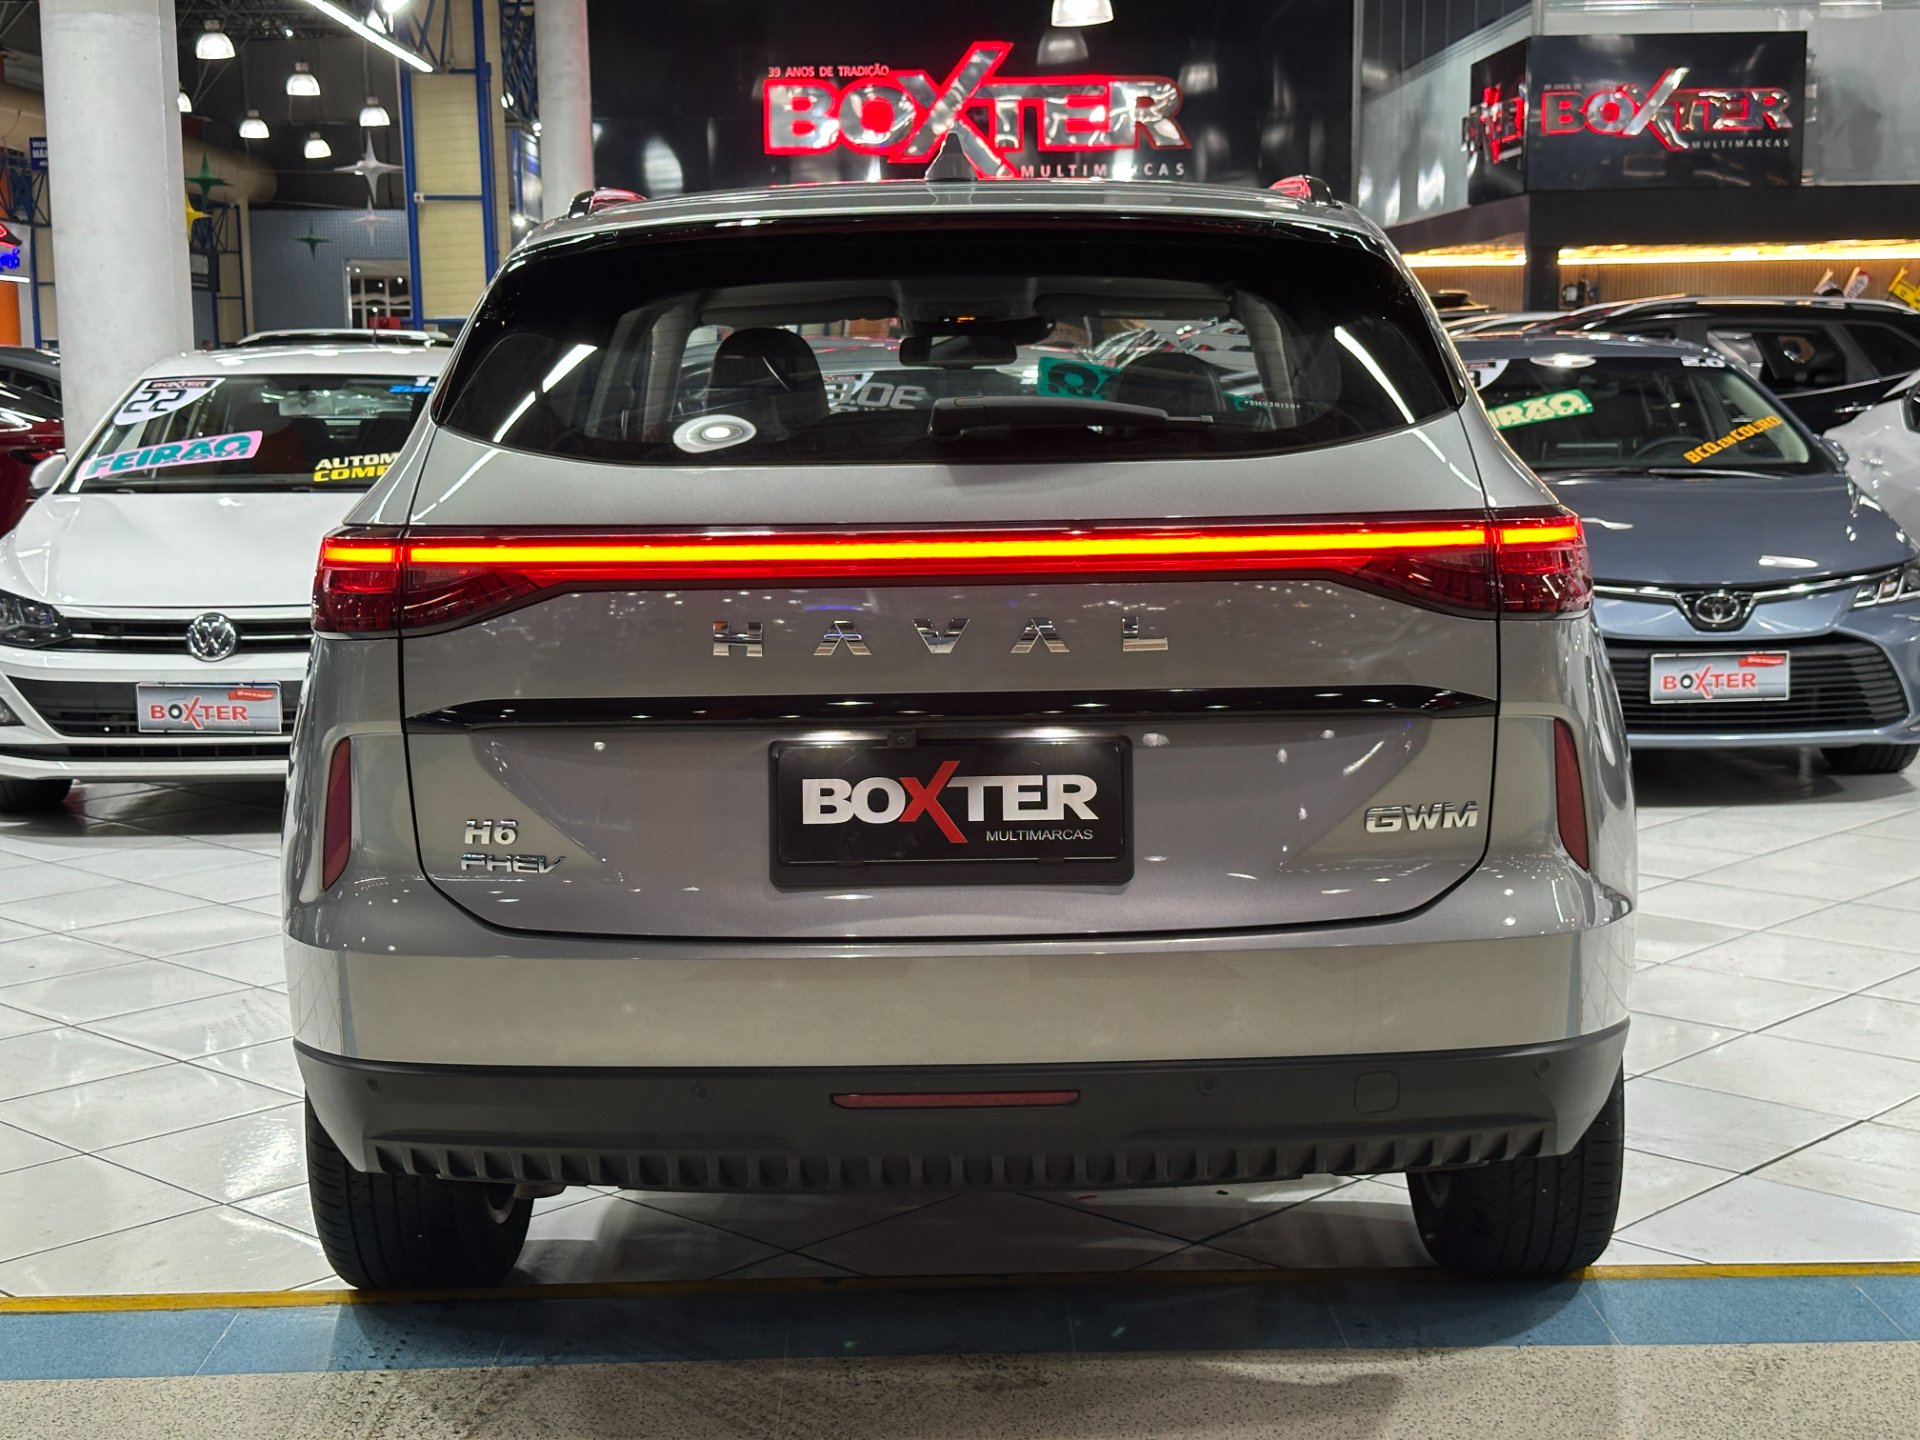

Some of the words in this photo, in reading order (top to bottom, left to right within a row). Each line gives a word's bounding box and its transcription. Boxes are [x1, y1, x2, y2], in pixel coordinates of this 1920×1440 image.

[768, 66, 781, 78] 39
[785, 66, 815, 78] ANOS
[819, 66, 833, 77] DE
[837, 63, 889, 78] TRADIÇÃO
[763, 41, 1192, 180] BOXTER
[1541, 66, 1793, 152] BOXTER
[1691, 138, 1790, 149] MULTIMARCAS
[151, 379, 208, 389] BOXTER
[123, 388, 188, 413] 22
[712, 615, 1169, 658] HAVAL
[1662, 664, 1758, 700] BOXTER
[149, 695, 249, 730] BOXTER
[802, 760, 1100, 844] BOXTER
[1365, 801, 1478, 833] GWM
[464, 819, 518, 845] H6
[986, 829, 1094, 842] MULTIMARCAS
[461, 853, 566, 873] PHEV
